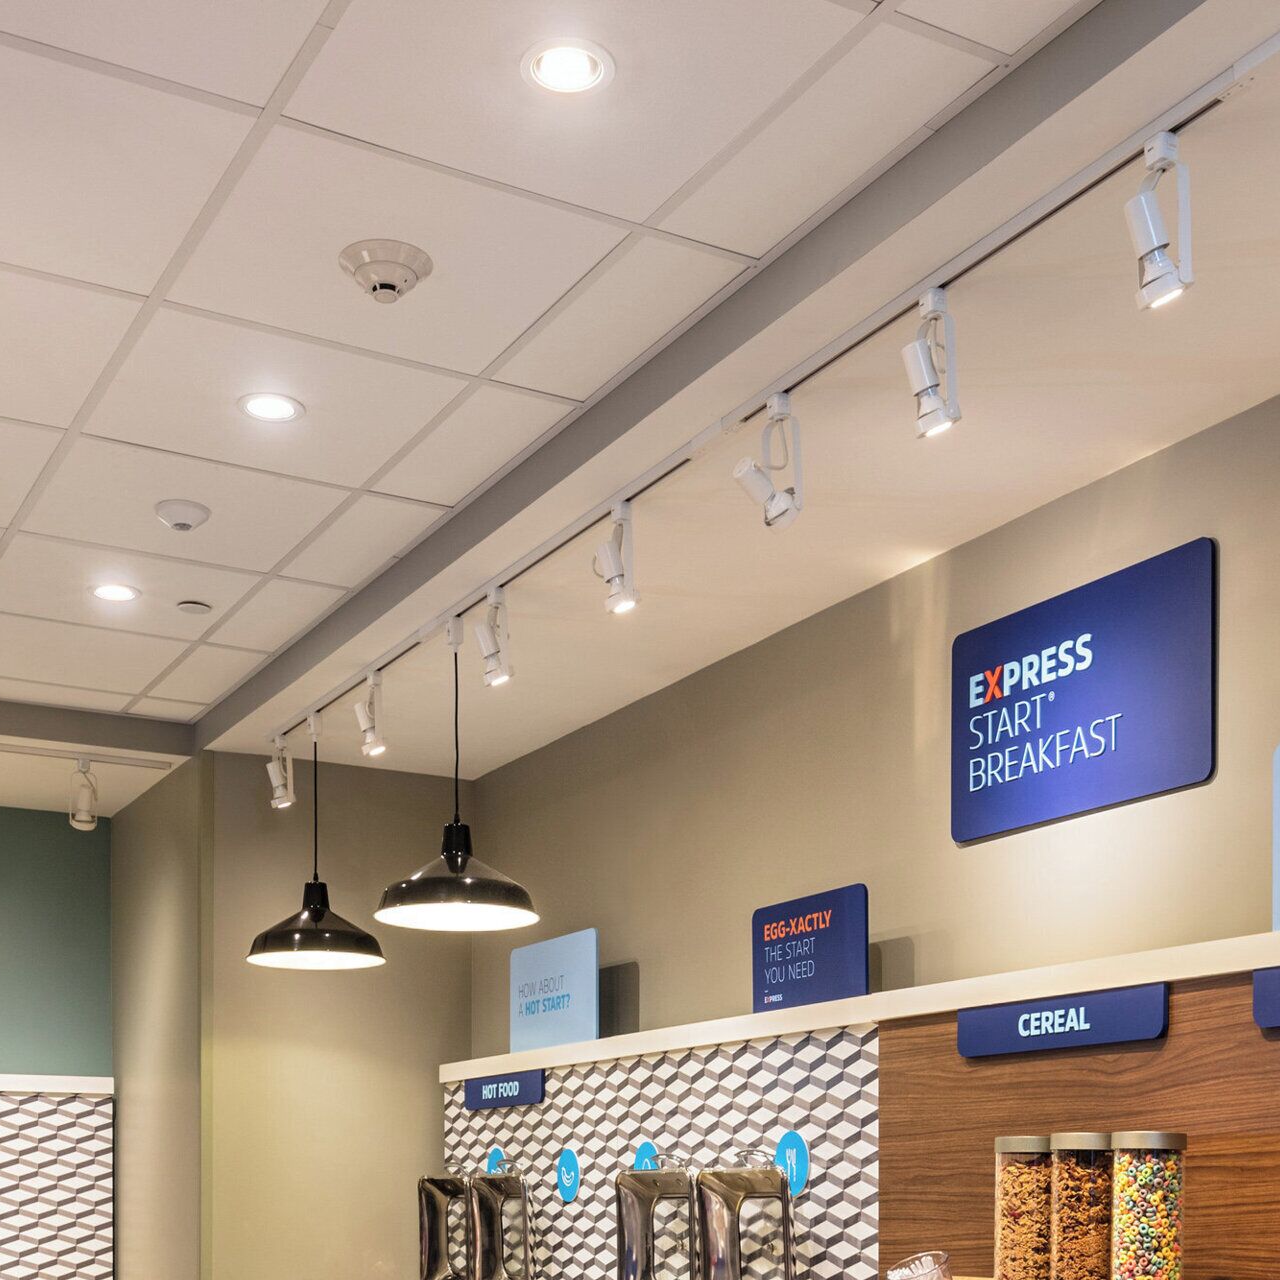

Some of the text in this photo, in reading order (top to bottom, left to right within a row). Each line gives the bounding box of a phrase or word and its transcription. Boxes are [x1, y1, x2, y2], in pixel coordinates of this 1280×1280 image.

[969, 633, 1093, 709] EXPRESS
[970, 713, 1123, 793] BREAKFAST
[763, 909, 833, 942] EGG-XACTLY
[764, 937, 816, 963] THE START
[764, 960, 816, 984] YOU NEED
[518, 975, 565, 999] HOW ABOUT
[764, 994, 783, 1004] EXPRESS
[518, 994, 571, 1017] A HOT START?
[1018, 1006, 1091, 1037] CEREAL
[482, 1081, 520, 1100] HOT FOOD
